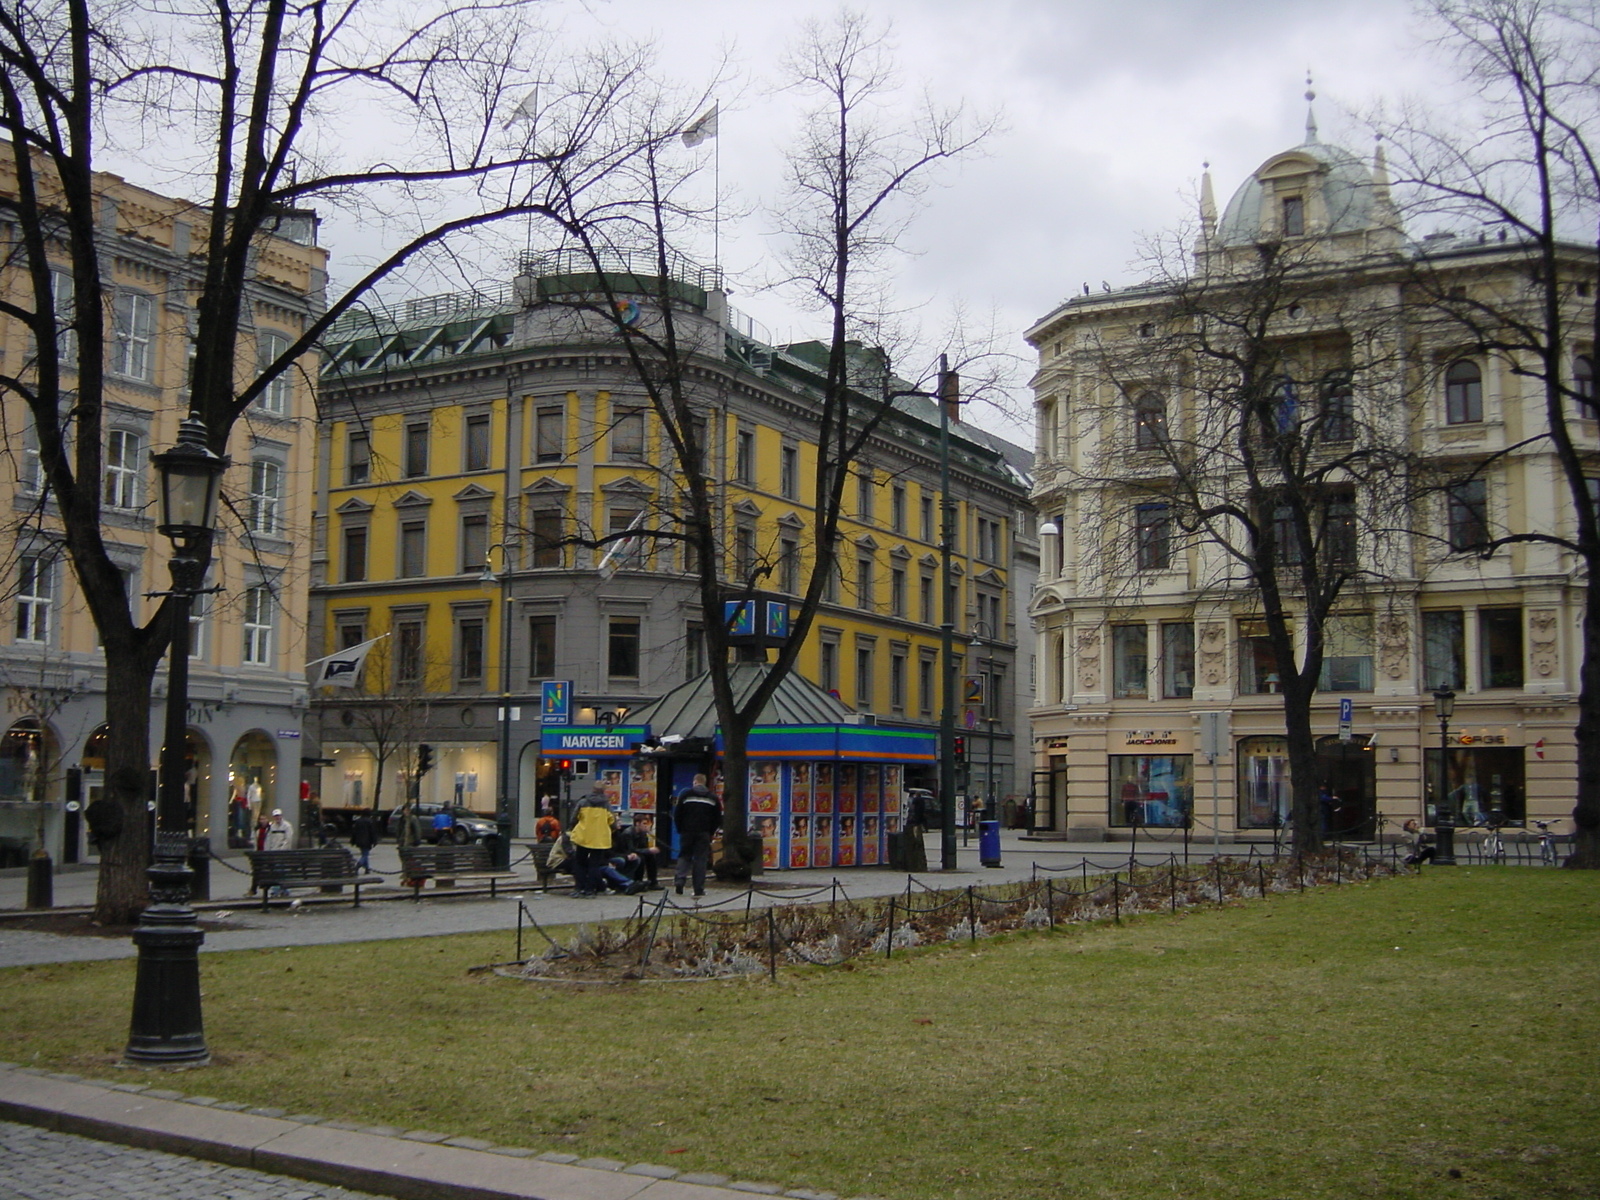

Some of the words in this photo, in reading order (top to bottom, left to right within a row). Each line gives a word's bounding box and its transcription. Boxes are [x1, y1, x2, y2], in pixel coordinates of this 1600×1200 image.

[965, 679, 982, 702] 2
[1342, 701, 1350, 719] P
[562, 736, 625, 748] NARVESEN
